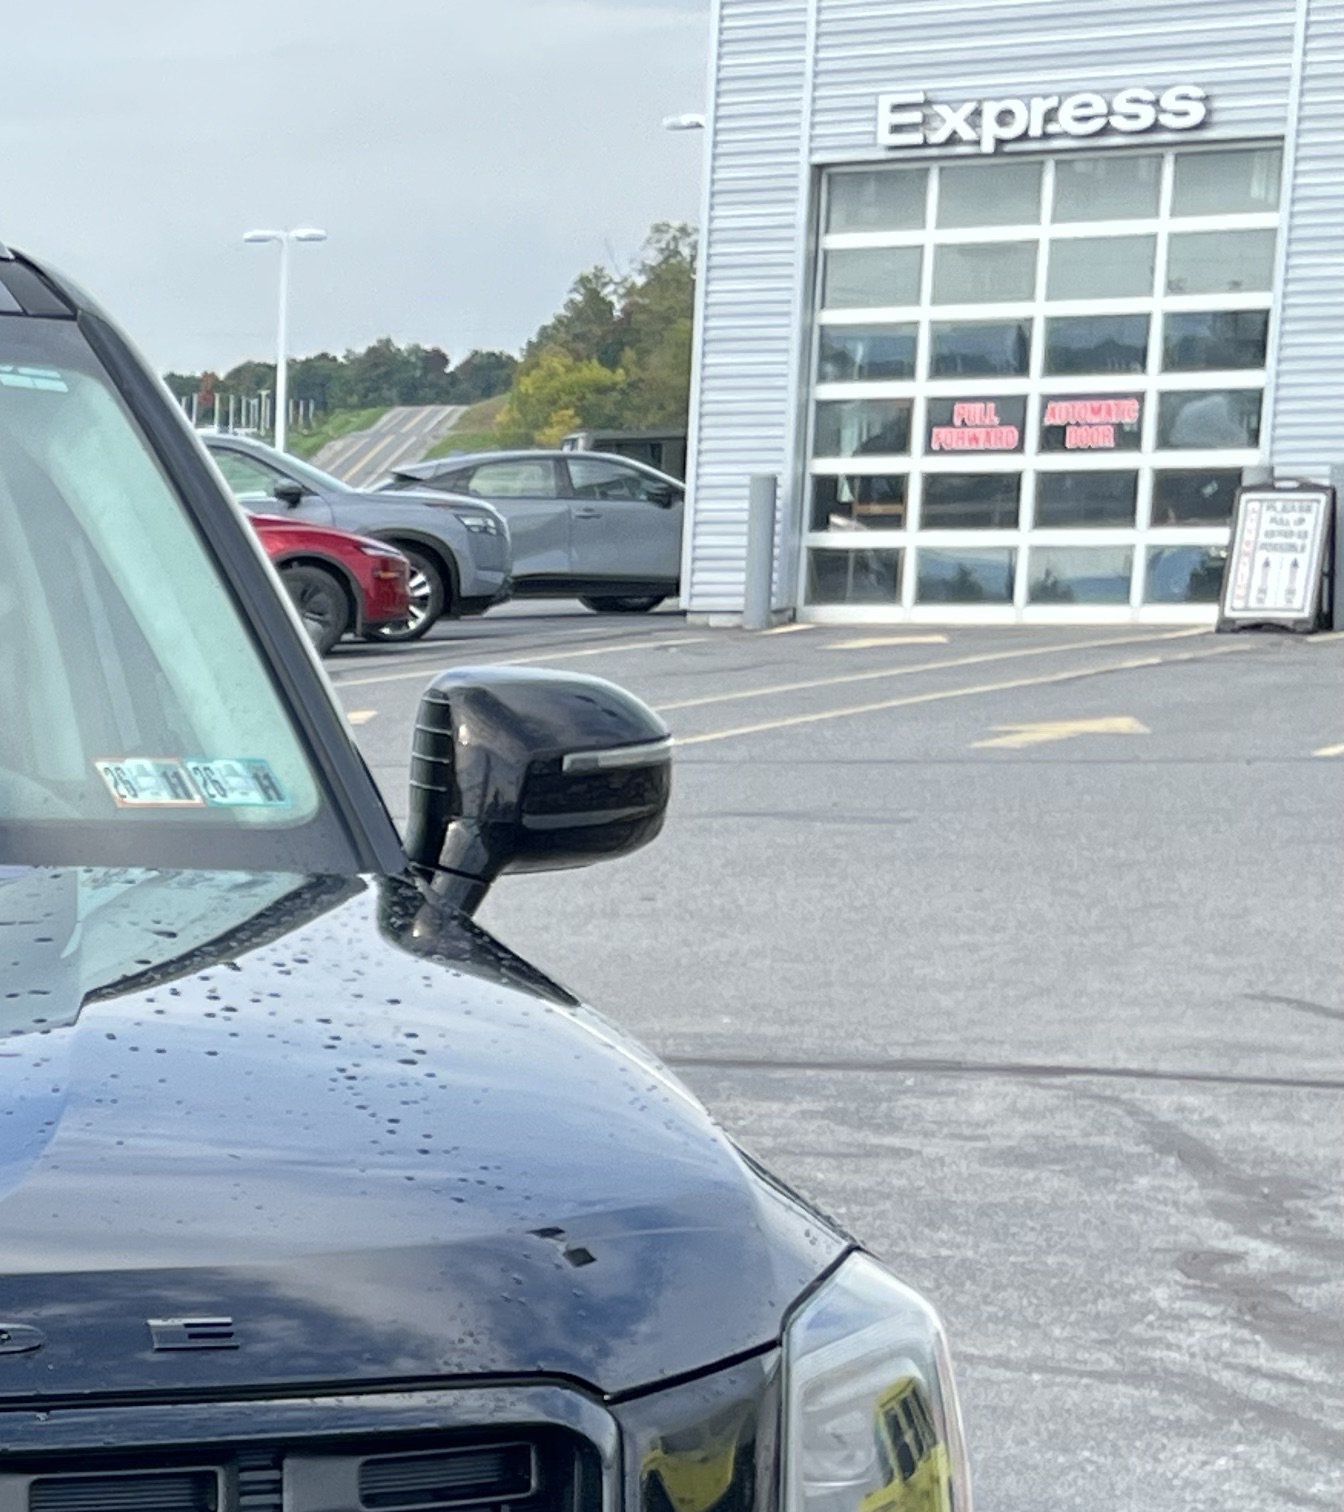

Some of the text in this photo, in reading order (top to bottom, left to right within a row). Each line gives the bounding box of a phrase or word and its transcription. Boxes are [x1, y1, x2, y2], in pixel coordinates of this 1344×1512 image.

[877, 85, 1208, 154] Express
[953, 402, 1000, 427] PULL
[1044, 398, 1140, 426] AUTOMATIC
[931, 427, 1019, 450] FORWARD
[1065, 425, 1115, 449] DOOR
